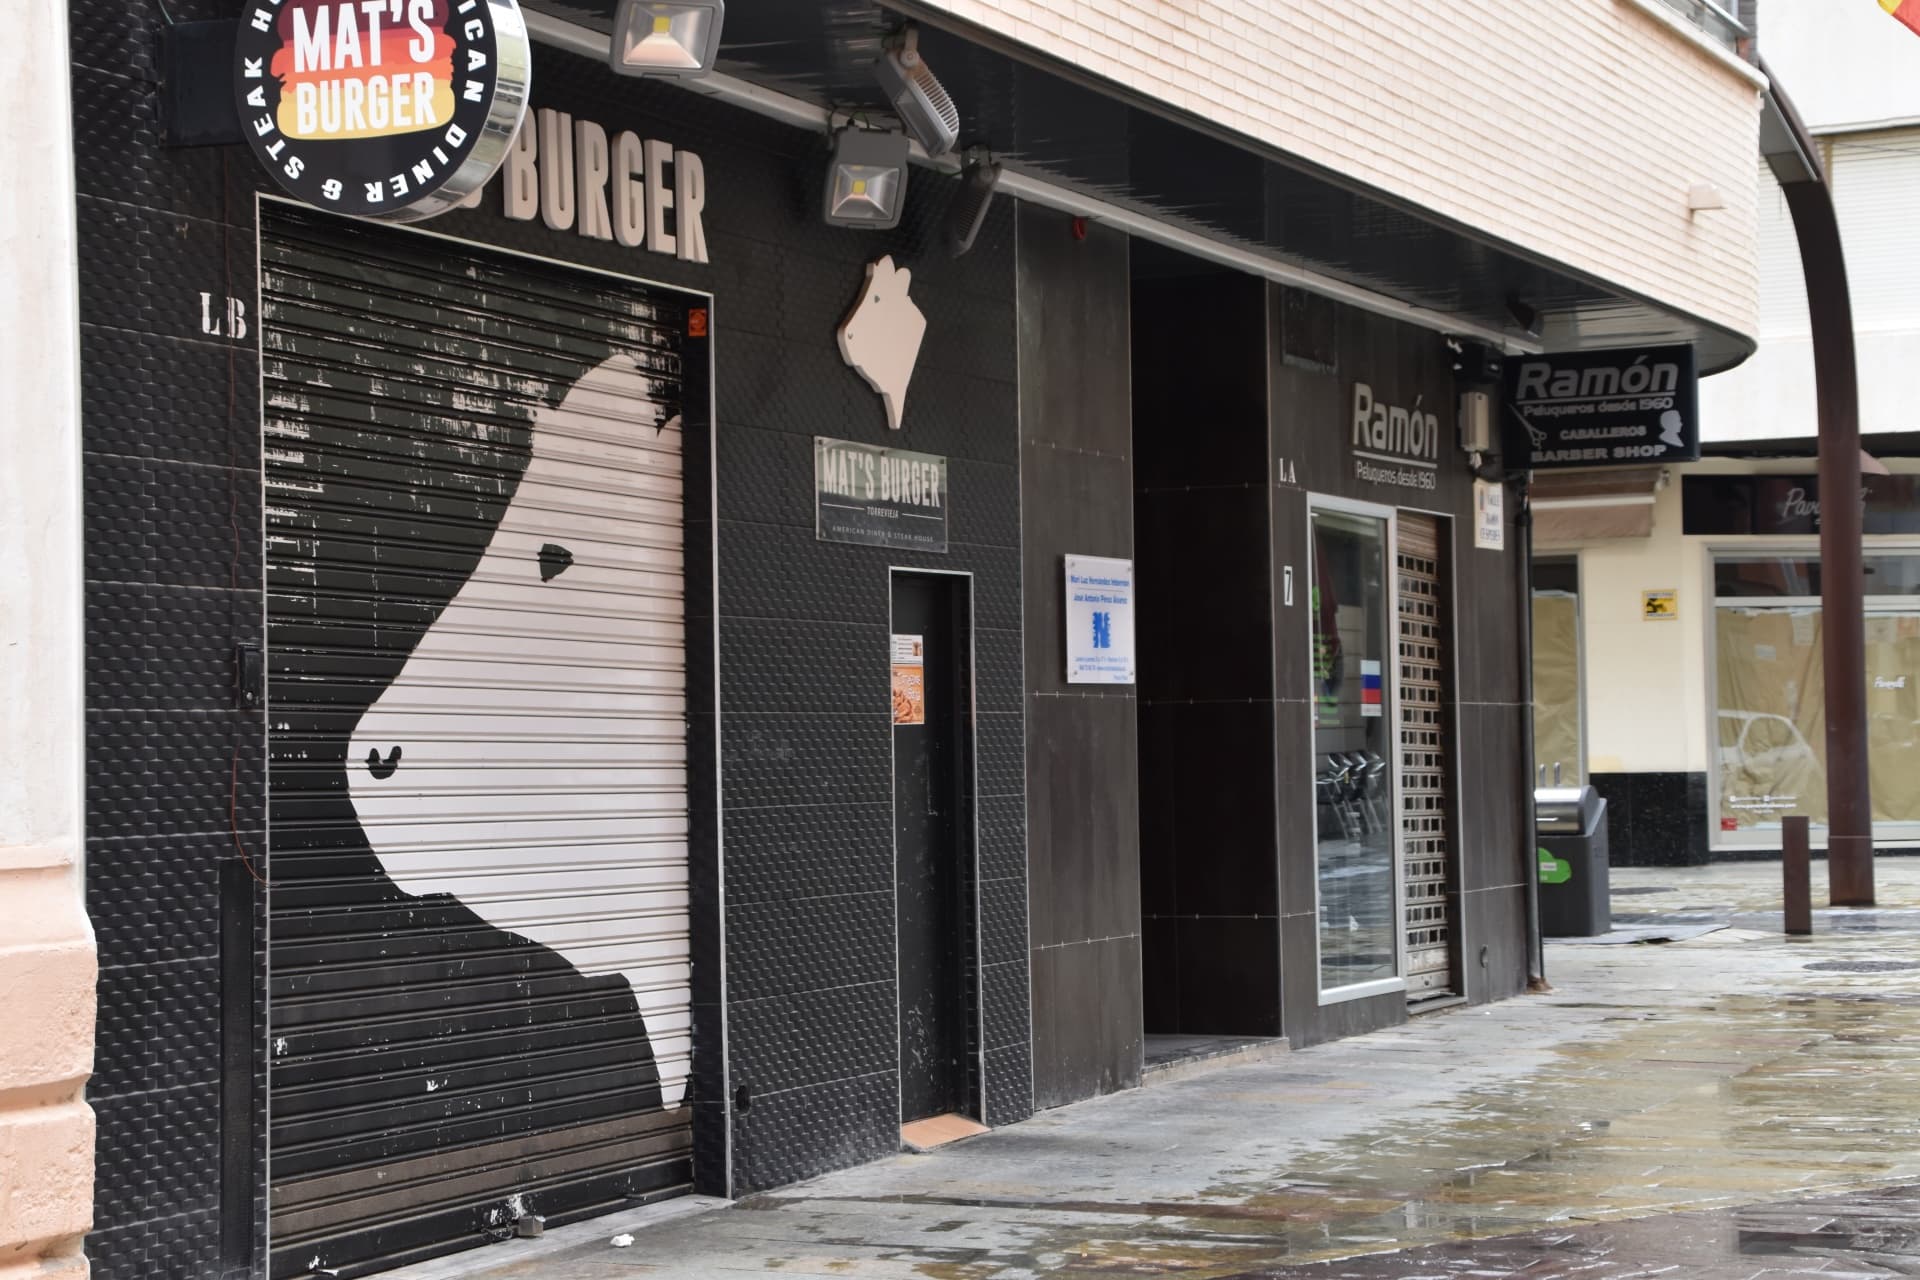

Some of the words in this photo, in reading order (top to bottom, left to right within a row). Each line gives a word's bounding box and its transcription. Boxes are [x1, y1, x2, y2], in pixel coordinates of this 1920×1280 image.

[292, 0, 436, 73] MAT'S
[244, 57, 305, 180] STEAK
[296, 72, 437, 135] BURGER
[321, 178, 344, 200] &
[364, 123, 468, 203] DINER
[504, 104, 709, 264] BURGER
[1515, 354, 1679, 400] Ramón
[1353, 382, 1438, 459] Ramón
[1559, 425, 1648, 440] CABALLEROS
[822, 447, 875, 500] MAT'S
[880, 456, 941, 508] BURGER
[1356, 460, 1398, 487] Peluqueros
[1418, 470, 1437, 490] 1960
[1530, 447, 1609, 463] BARBER
[1613, 444, 1668, 459] SHOP
[832, 525, 865, 536] AMERICAN
